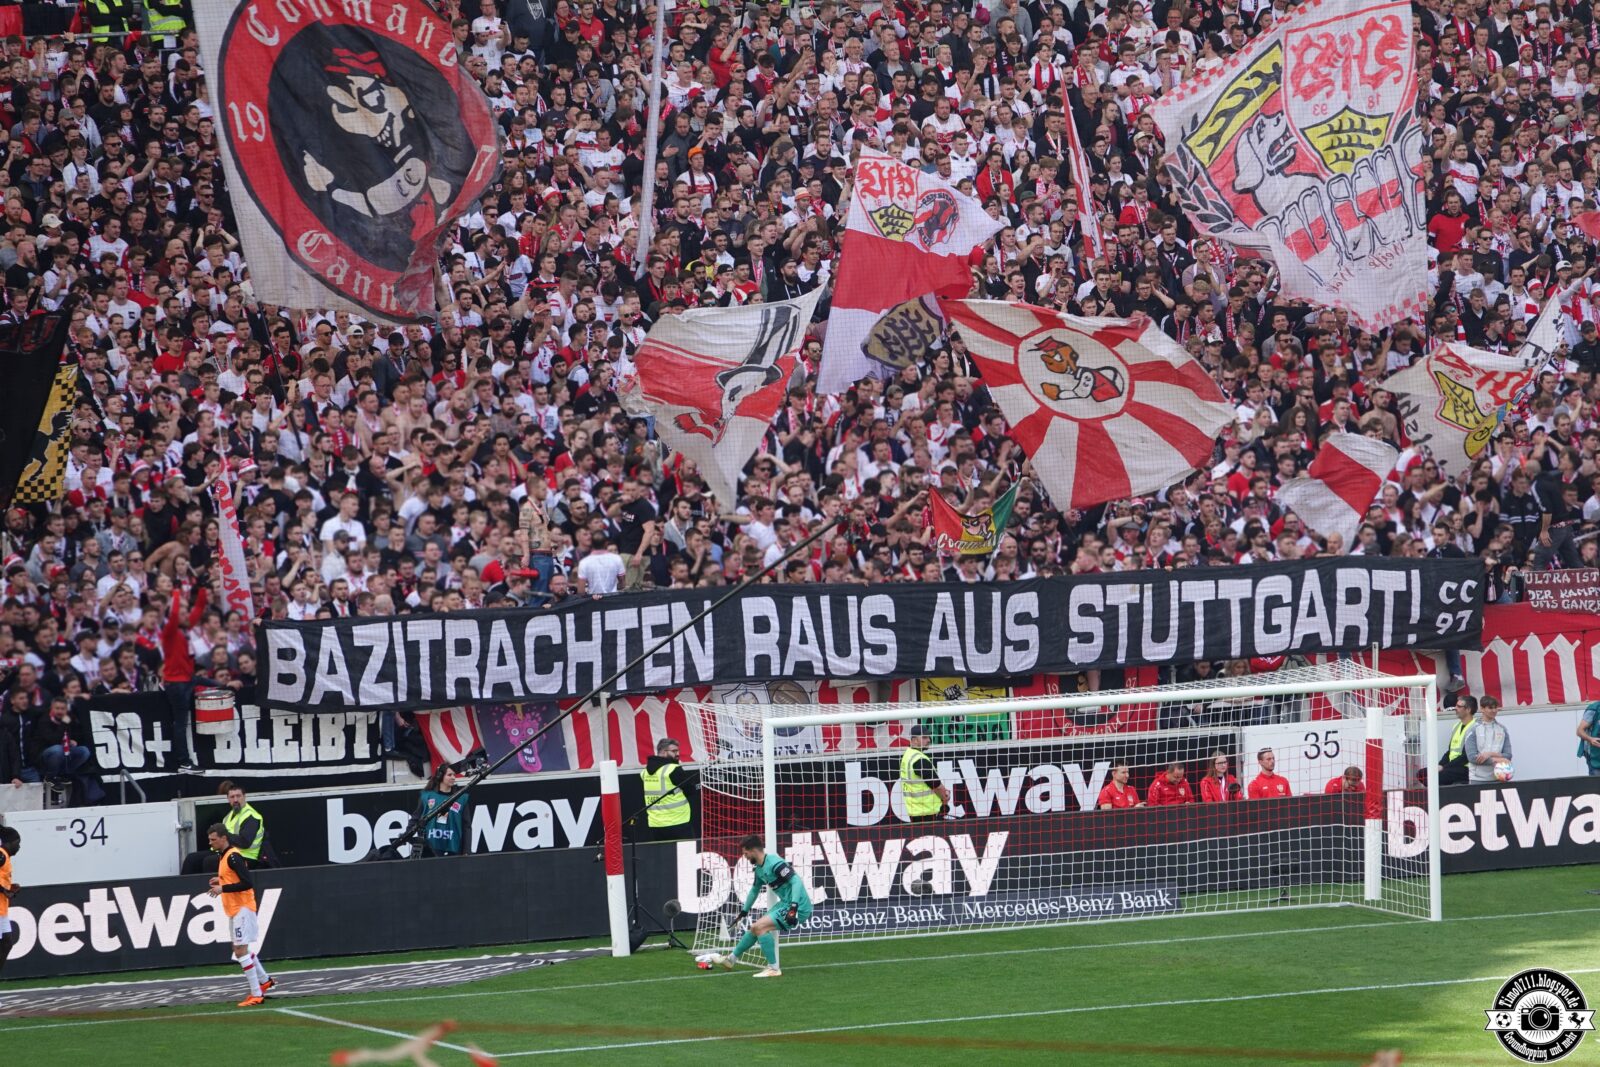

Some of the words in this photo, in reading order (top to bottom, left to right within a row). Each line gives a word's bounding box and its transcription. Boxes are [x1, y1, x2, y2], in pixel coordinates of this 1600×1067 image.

[228, 101, 267, 143] 19
[856, 160, 918, 201] VfB
[1438, 579, 1479, 605] CC
[1525, 572, 1571, 585] ULTRA
[1576, 571, 1600, 584] IST
[1528, 589, 1554, 600] DER
[266, 600, 715, 707] BAZITRACHTEN
[741, 594, 898, 677] RAUS
[923, 591, 1040, 673] AUS
[1066, 567, 1422, 666] STUTTGART!
[1434, 608, 1474, 636] 97
[1303, 730, 1340, 760] 35
[69, 816, 109, 848] 34
[326, 795, 601, 864] beway
[428, 828, 454, 840] HOST
[893, 903, 948, 924] Bank
[964, 896, 1119, 921] Mercedes-Benz
[1120, 888, 1173, 911] Bank
